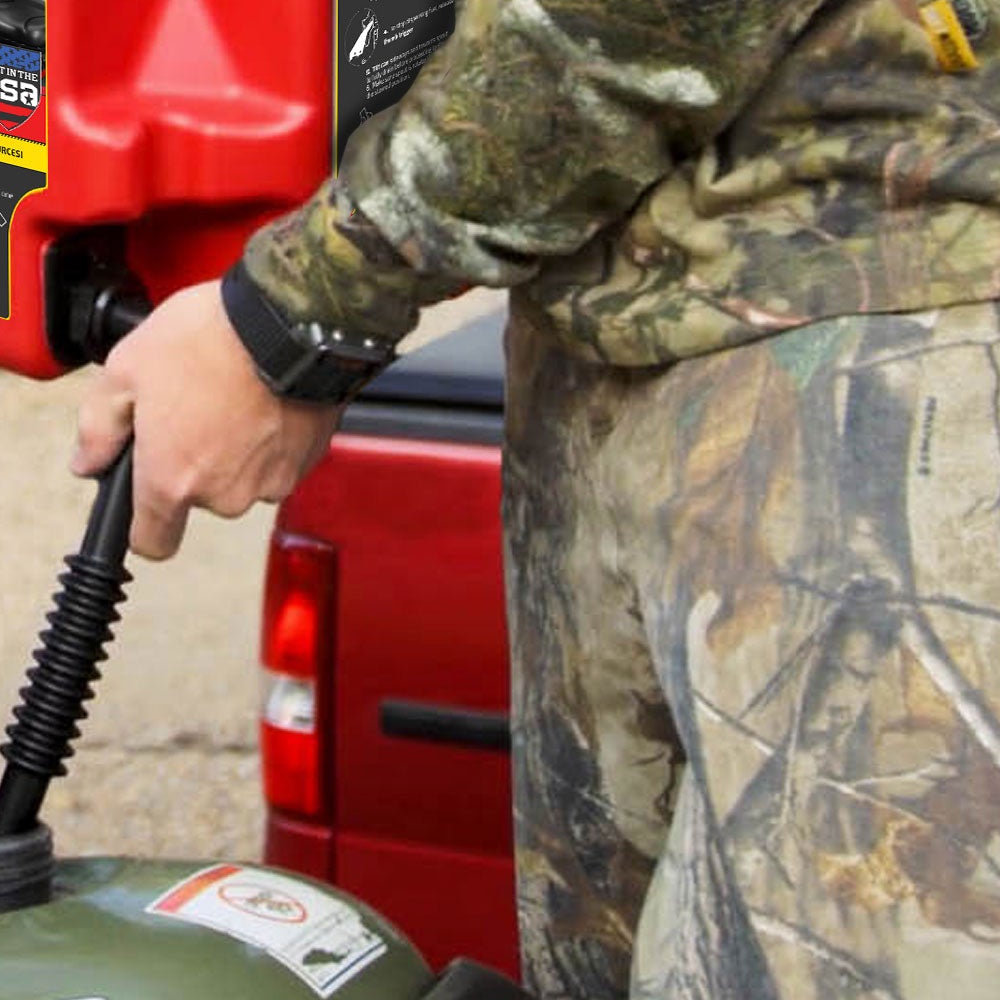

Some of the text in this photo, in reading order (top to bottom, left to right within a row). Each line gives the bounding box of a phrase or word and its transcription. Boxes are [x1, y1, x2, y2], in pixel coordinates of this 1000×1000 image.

[6, 67, 17, 78] IN
[18, 70, 39, 82] THE
[0, 190, 14, 199] one
